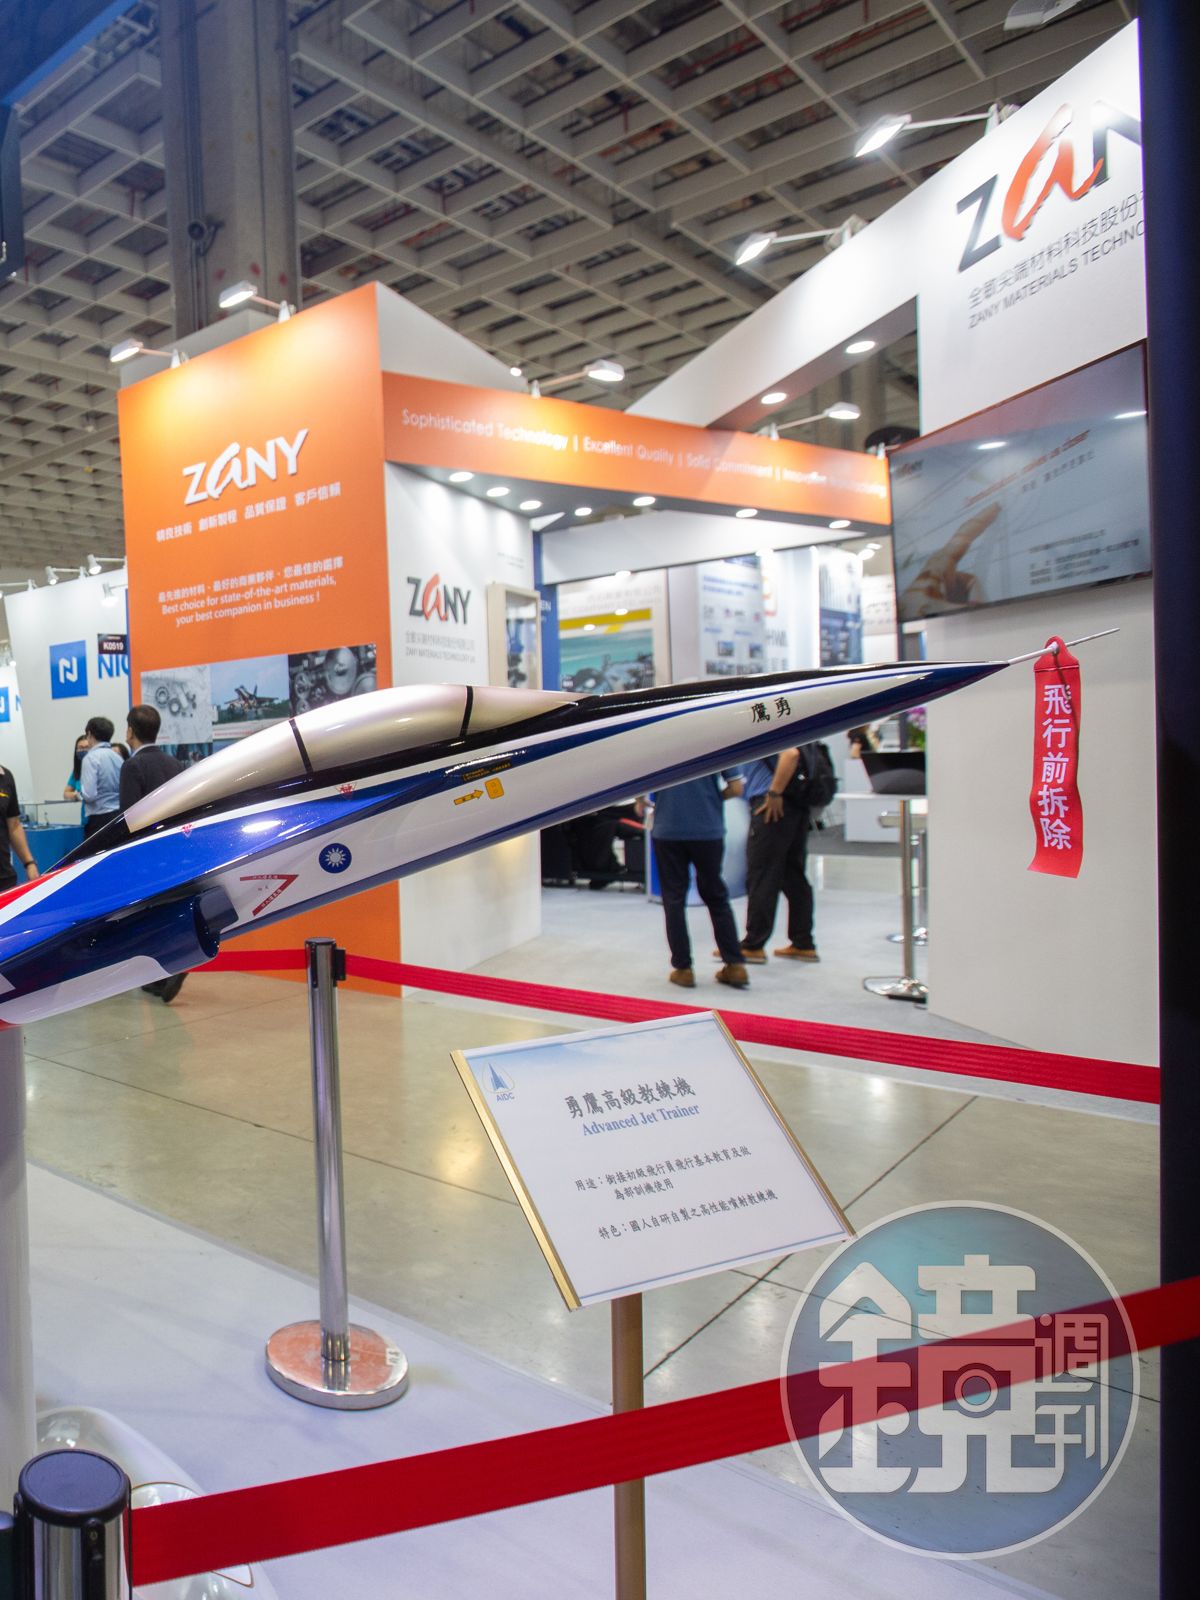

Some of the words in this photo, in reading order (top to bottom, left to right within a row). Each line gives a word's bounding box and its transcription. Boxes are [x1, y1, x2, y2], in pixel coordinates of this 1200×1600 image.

[1003, 258, 1079, 310] MATERIALS
[402, 408, 493, 437] Sophisticated
[162, 603, 180, 615] Best
[180, 599, 205, 612] choice
[206, 596, 219, 607] for
[176, 614, 194, 628] your
[195, 609, 213, 622] best
[214, 603, 262, 621] companion
[274, 594, 314, 609] business
[103, 641, 124, 651] K0519
[1037, 684, 1072, 850] 飛行前拆除
[496, 1091, 515, 1102] AIDC
[564, 1076, 696, 1119] 勇鷹高級教練機
[582, 1114, 639, 1137] Advanced
[640, 1111, 658, 1124] Jet
[658, 1103, 700, 1121] Trainer
